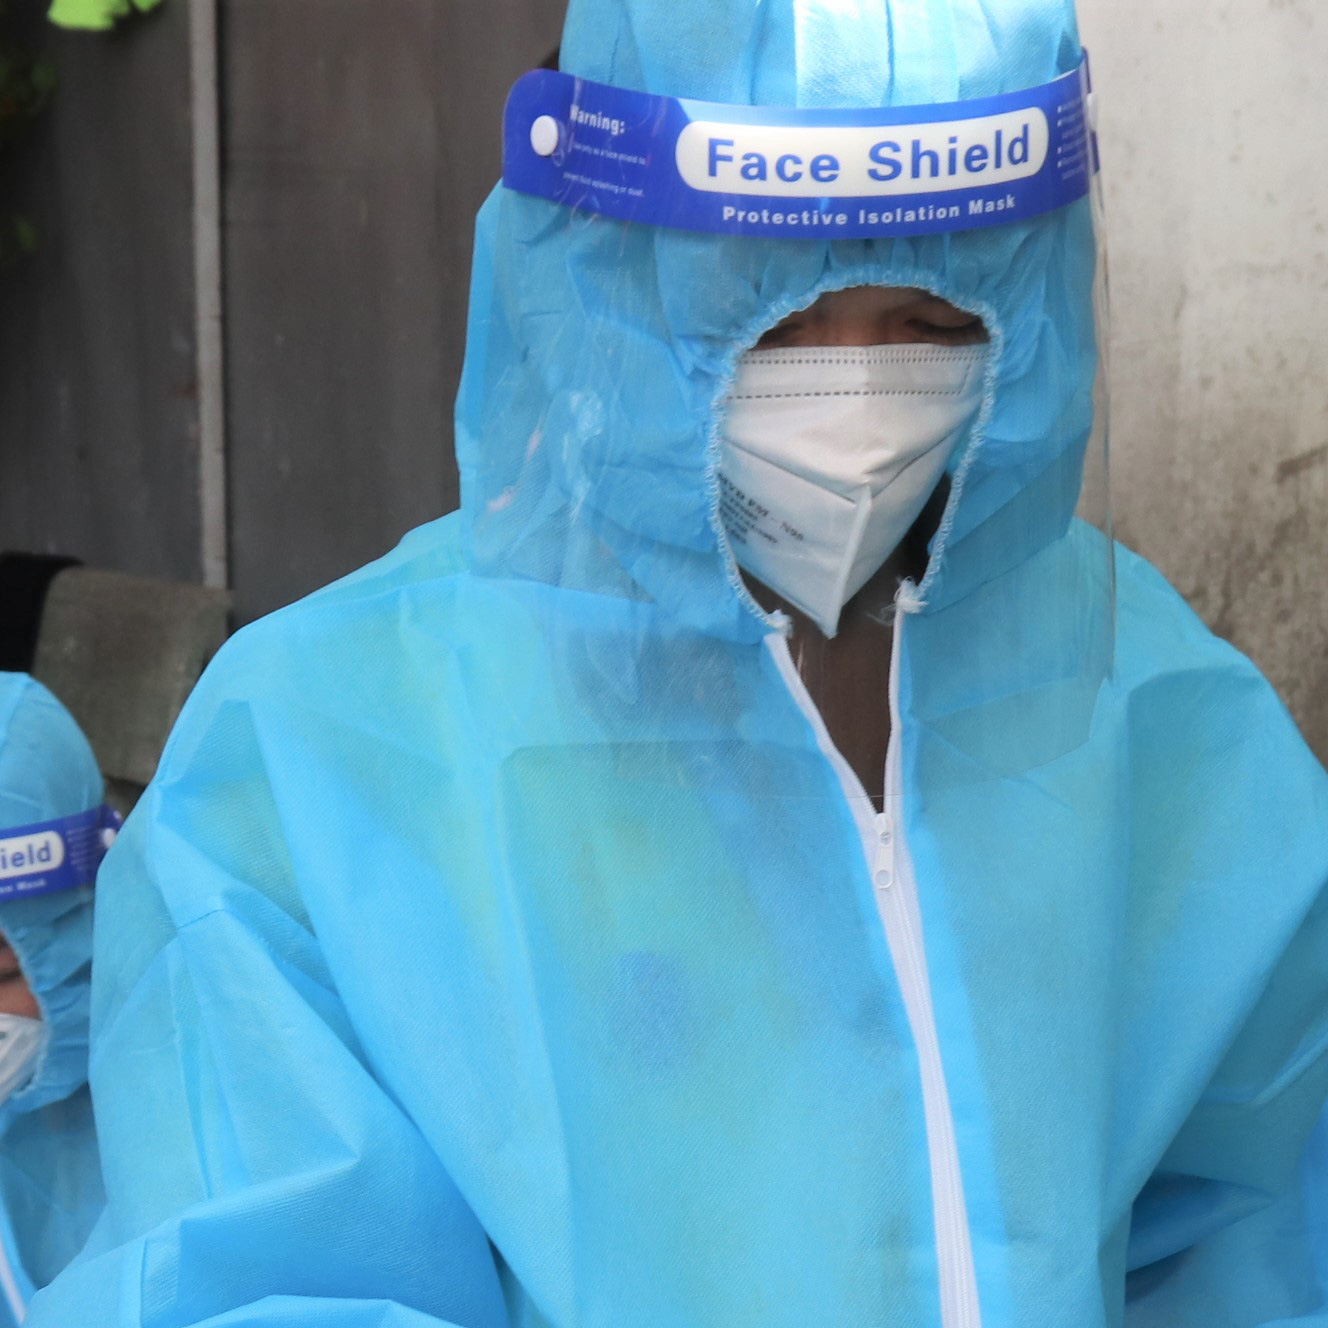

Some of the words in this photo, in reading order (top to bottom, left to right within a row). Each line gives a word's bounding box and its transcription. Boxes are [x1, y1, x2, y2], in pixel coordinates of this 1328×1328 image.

[707, 137, 840, 182] Face
[867, 123, 1029, 181] Shield
[722, 206, 848, 225] Protective
[859, 204, 960, 224] Isolation
[968, 194, 1015, 215] Mask
